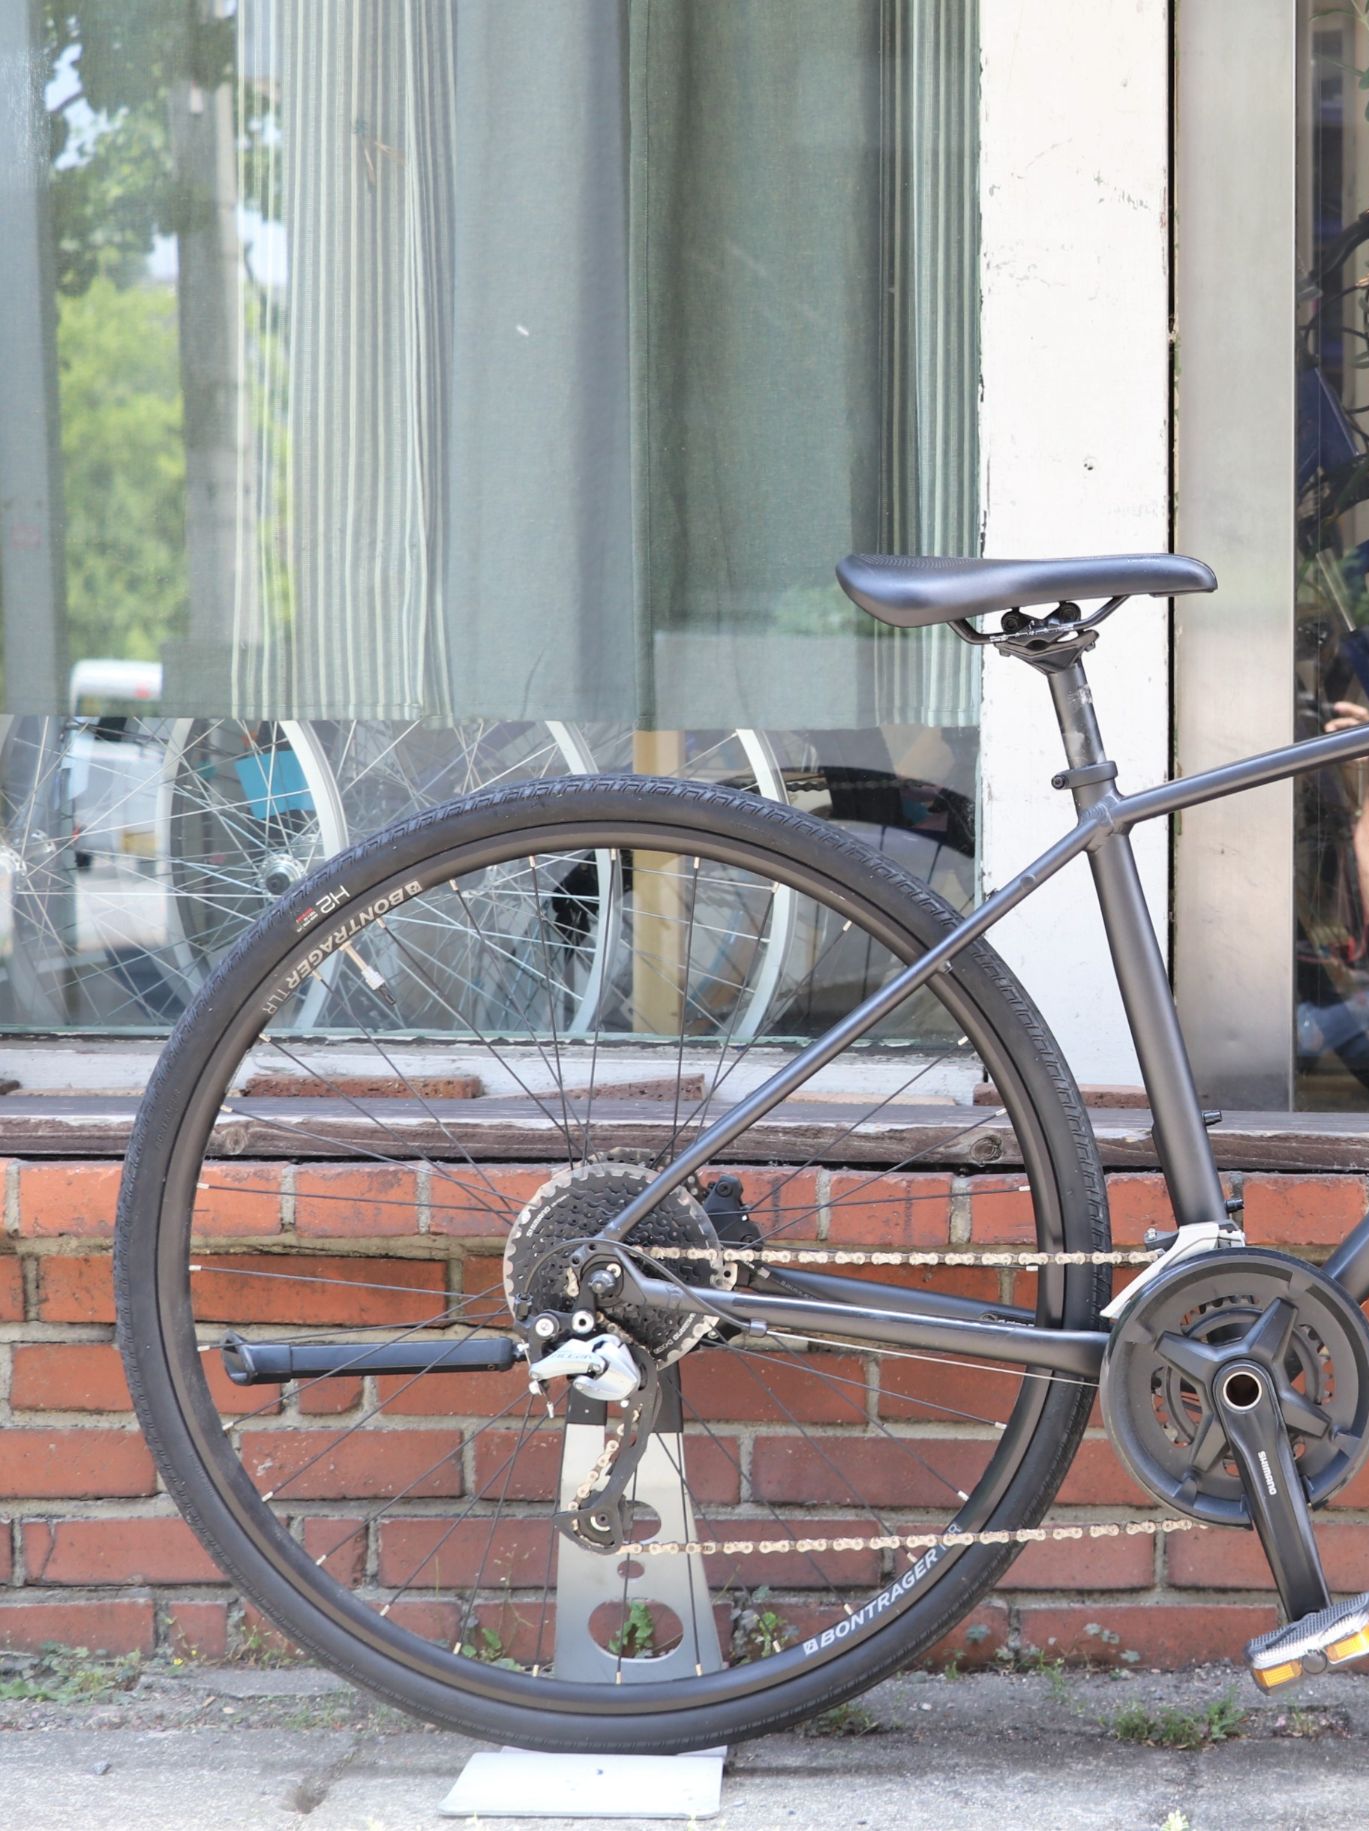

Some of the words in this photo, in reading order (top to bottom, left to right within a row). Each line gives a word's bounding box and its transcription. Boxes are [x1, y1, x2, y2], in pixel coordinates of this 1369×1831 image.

[315, 885, 350, 914] H2
[285, 889, 406, 989] BONTRAGER
[262, 989, 290, 1015] TLR
[1257, 1450, 1277, 1496] SHIMANO
[820, 1548, 938, 1648] BONTRAGER
